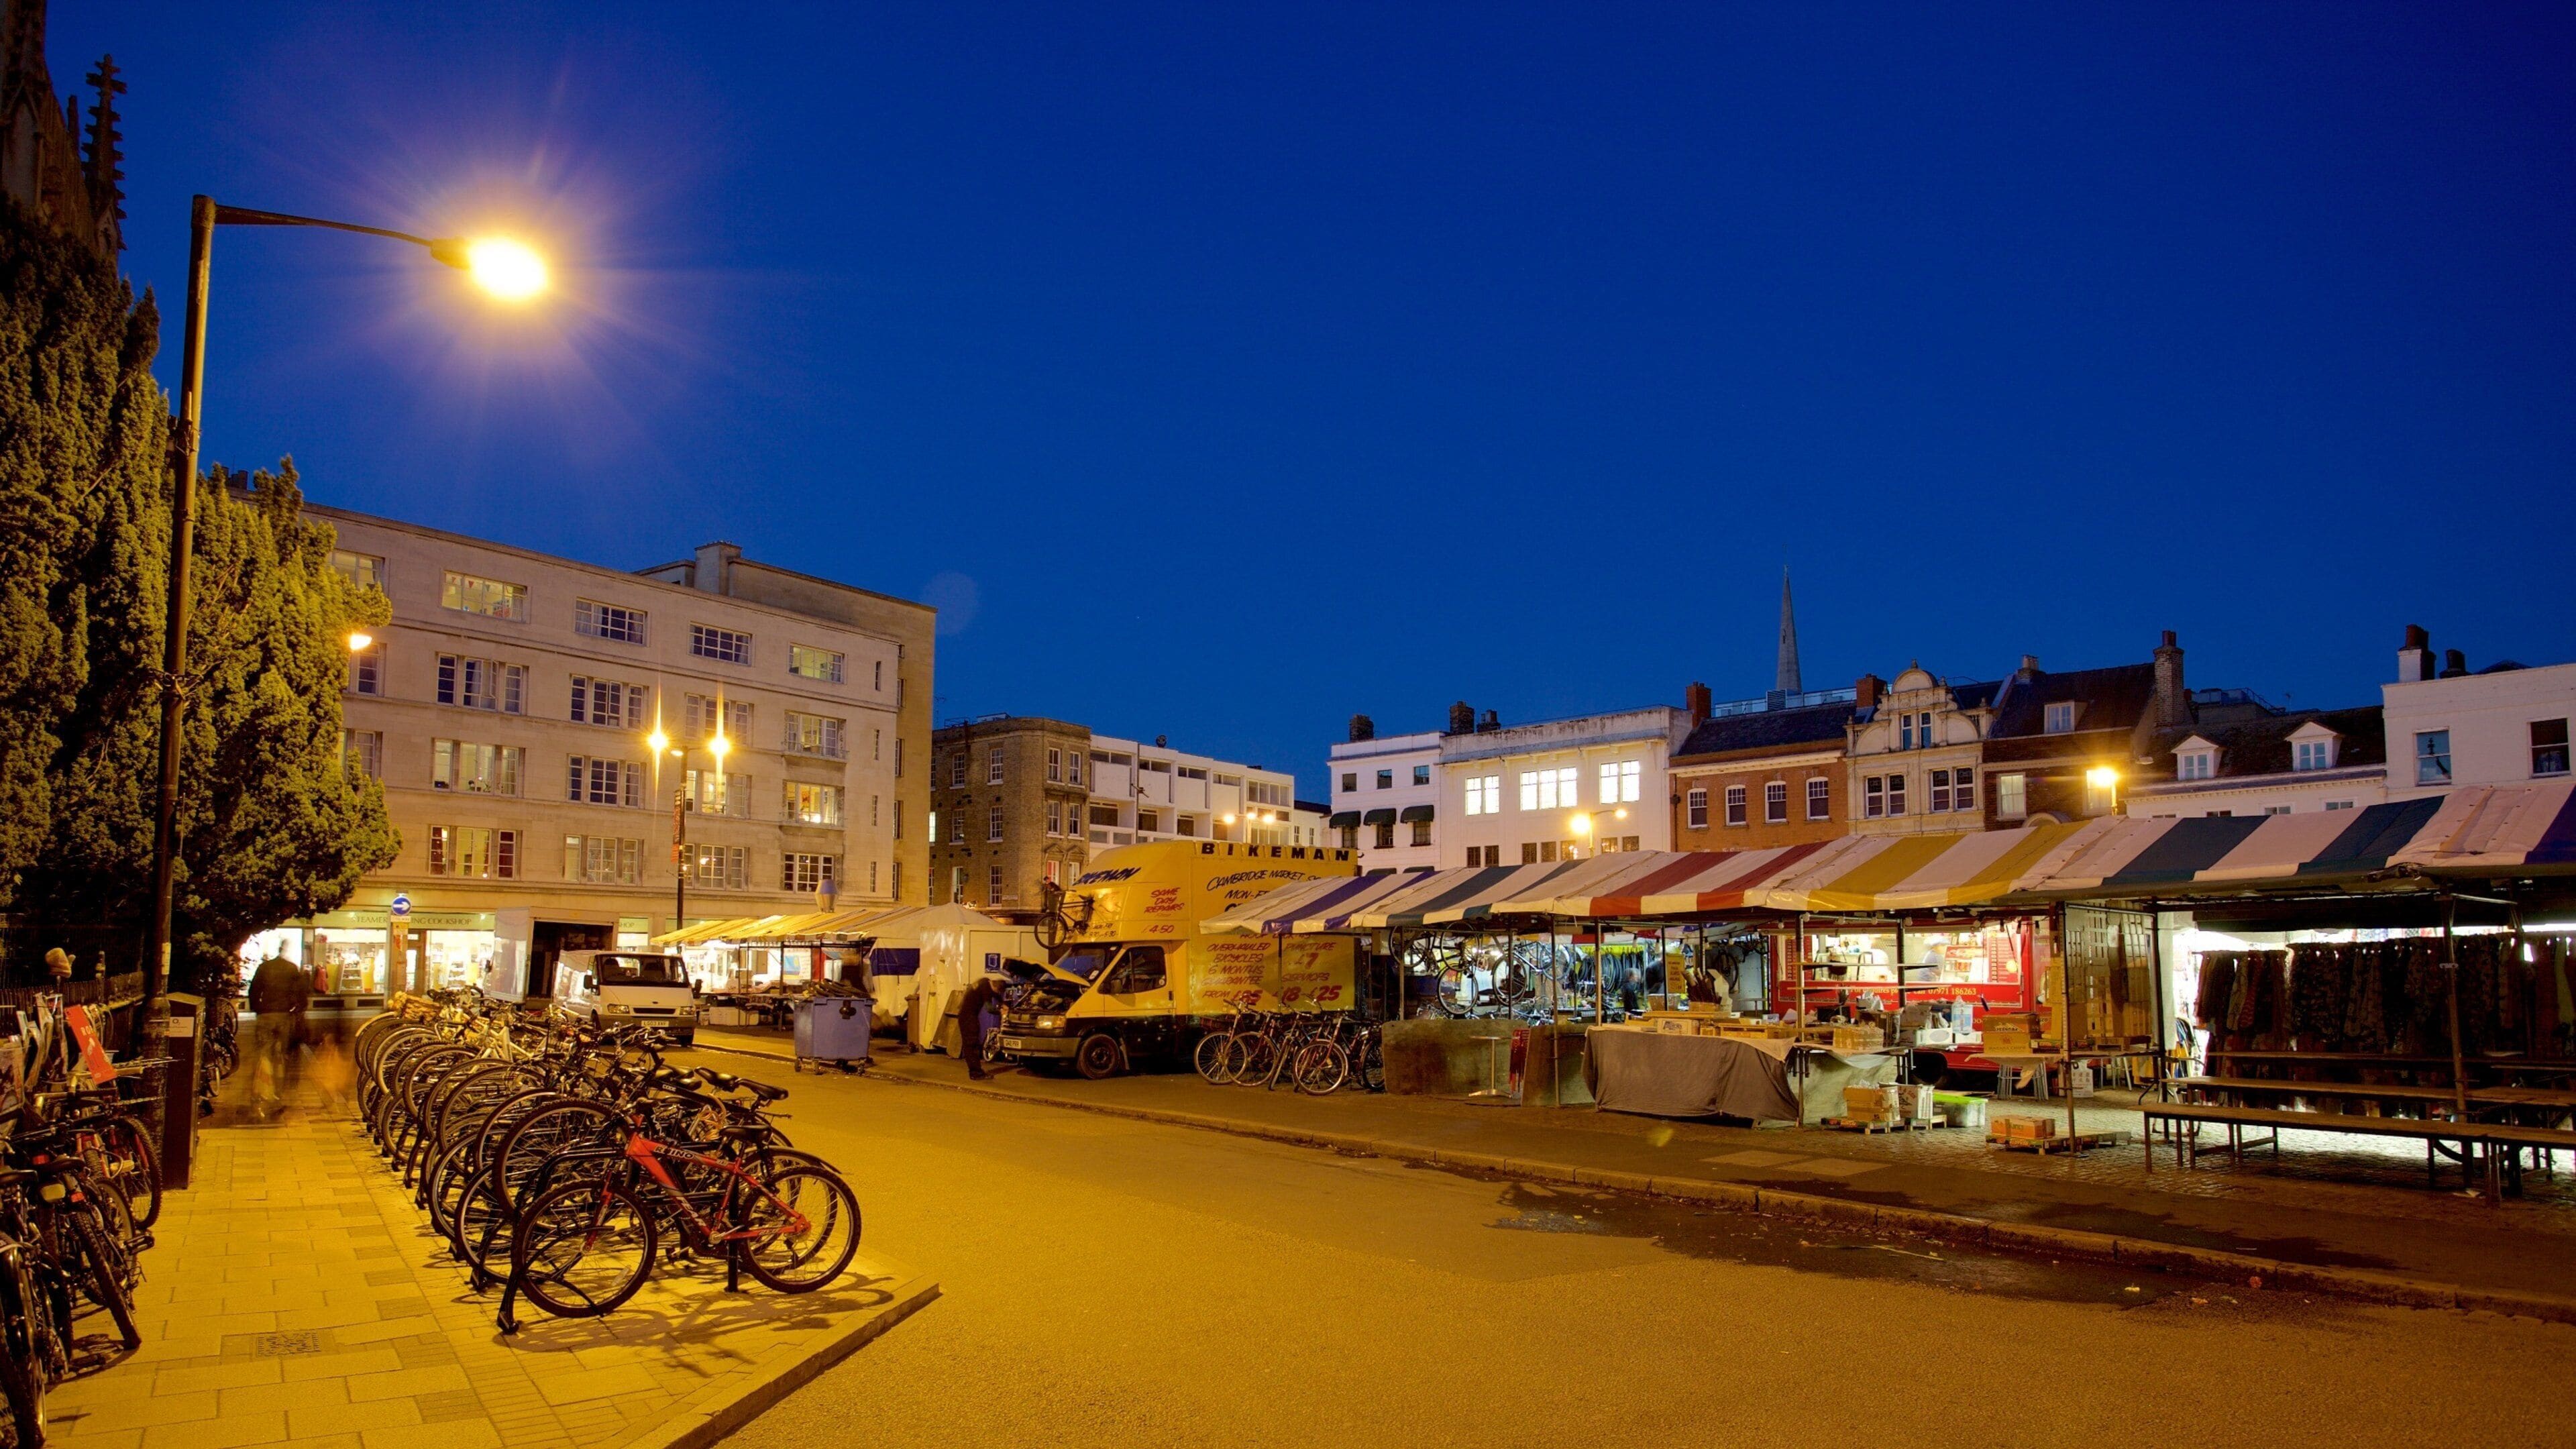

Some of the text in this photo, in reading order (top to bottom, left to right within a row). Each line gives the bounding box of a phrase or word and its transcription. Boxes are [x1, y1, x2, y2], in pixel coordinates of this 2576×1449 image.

[1201, 843, 1349, 861] BIKEMAN
[1206, 869, 1305, 892] CAMBRIDGE MARKET
[1155, 896, 1177, 905] DAY
[1144, 903, 1185, 913] REPAIRS
[1207, 943, 1271, 952] OVERHAULED
[1284, 942, 1337, 951] PUNCTURE
[1214, 953, 1264, 963] BICYCLES
[1220, 965, 1265, 975] MONTHS
[1201, 975, 1264, 985] GUARANTEE
[1202, 990, 1231, 998] FROM
[1928, 987, 1949, 995] 07971
[1951, 987, 1976, 996] 186263
